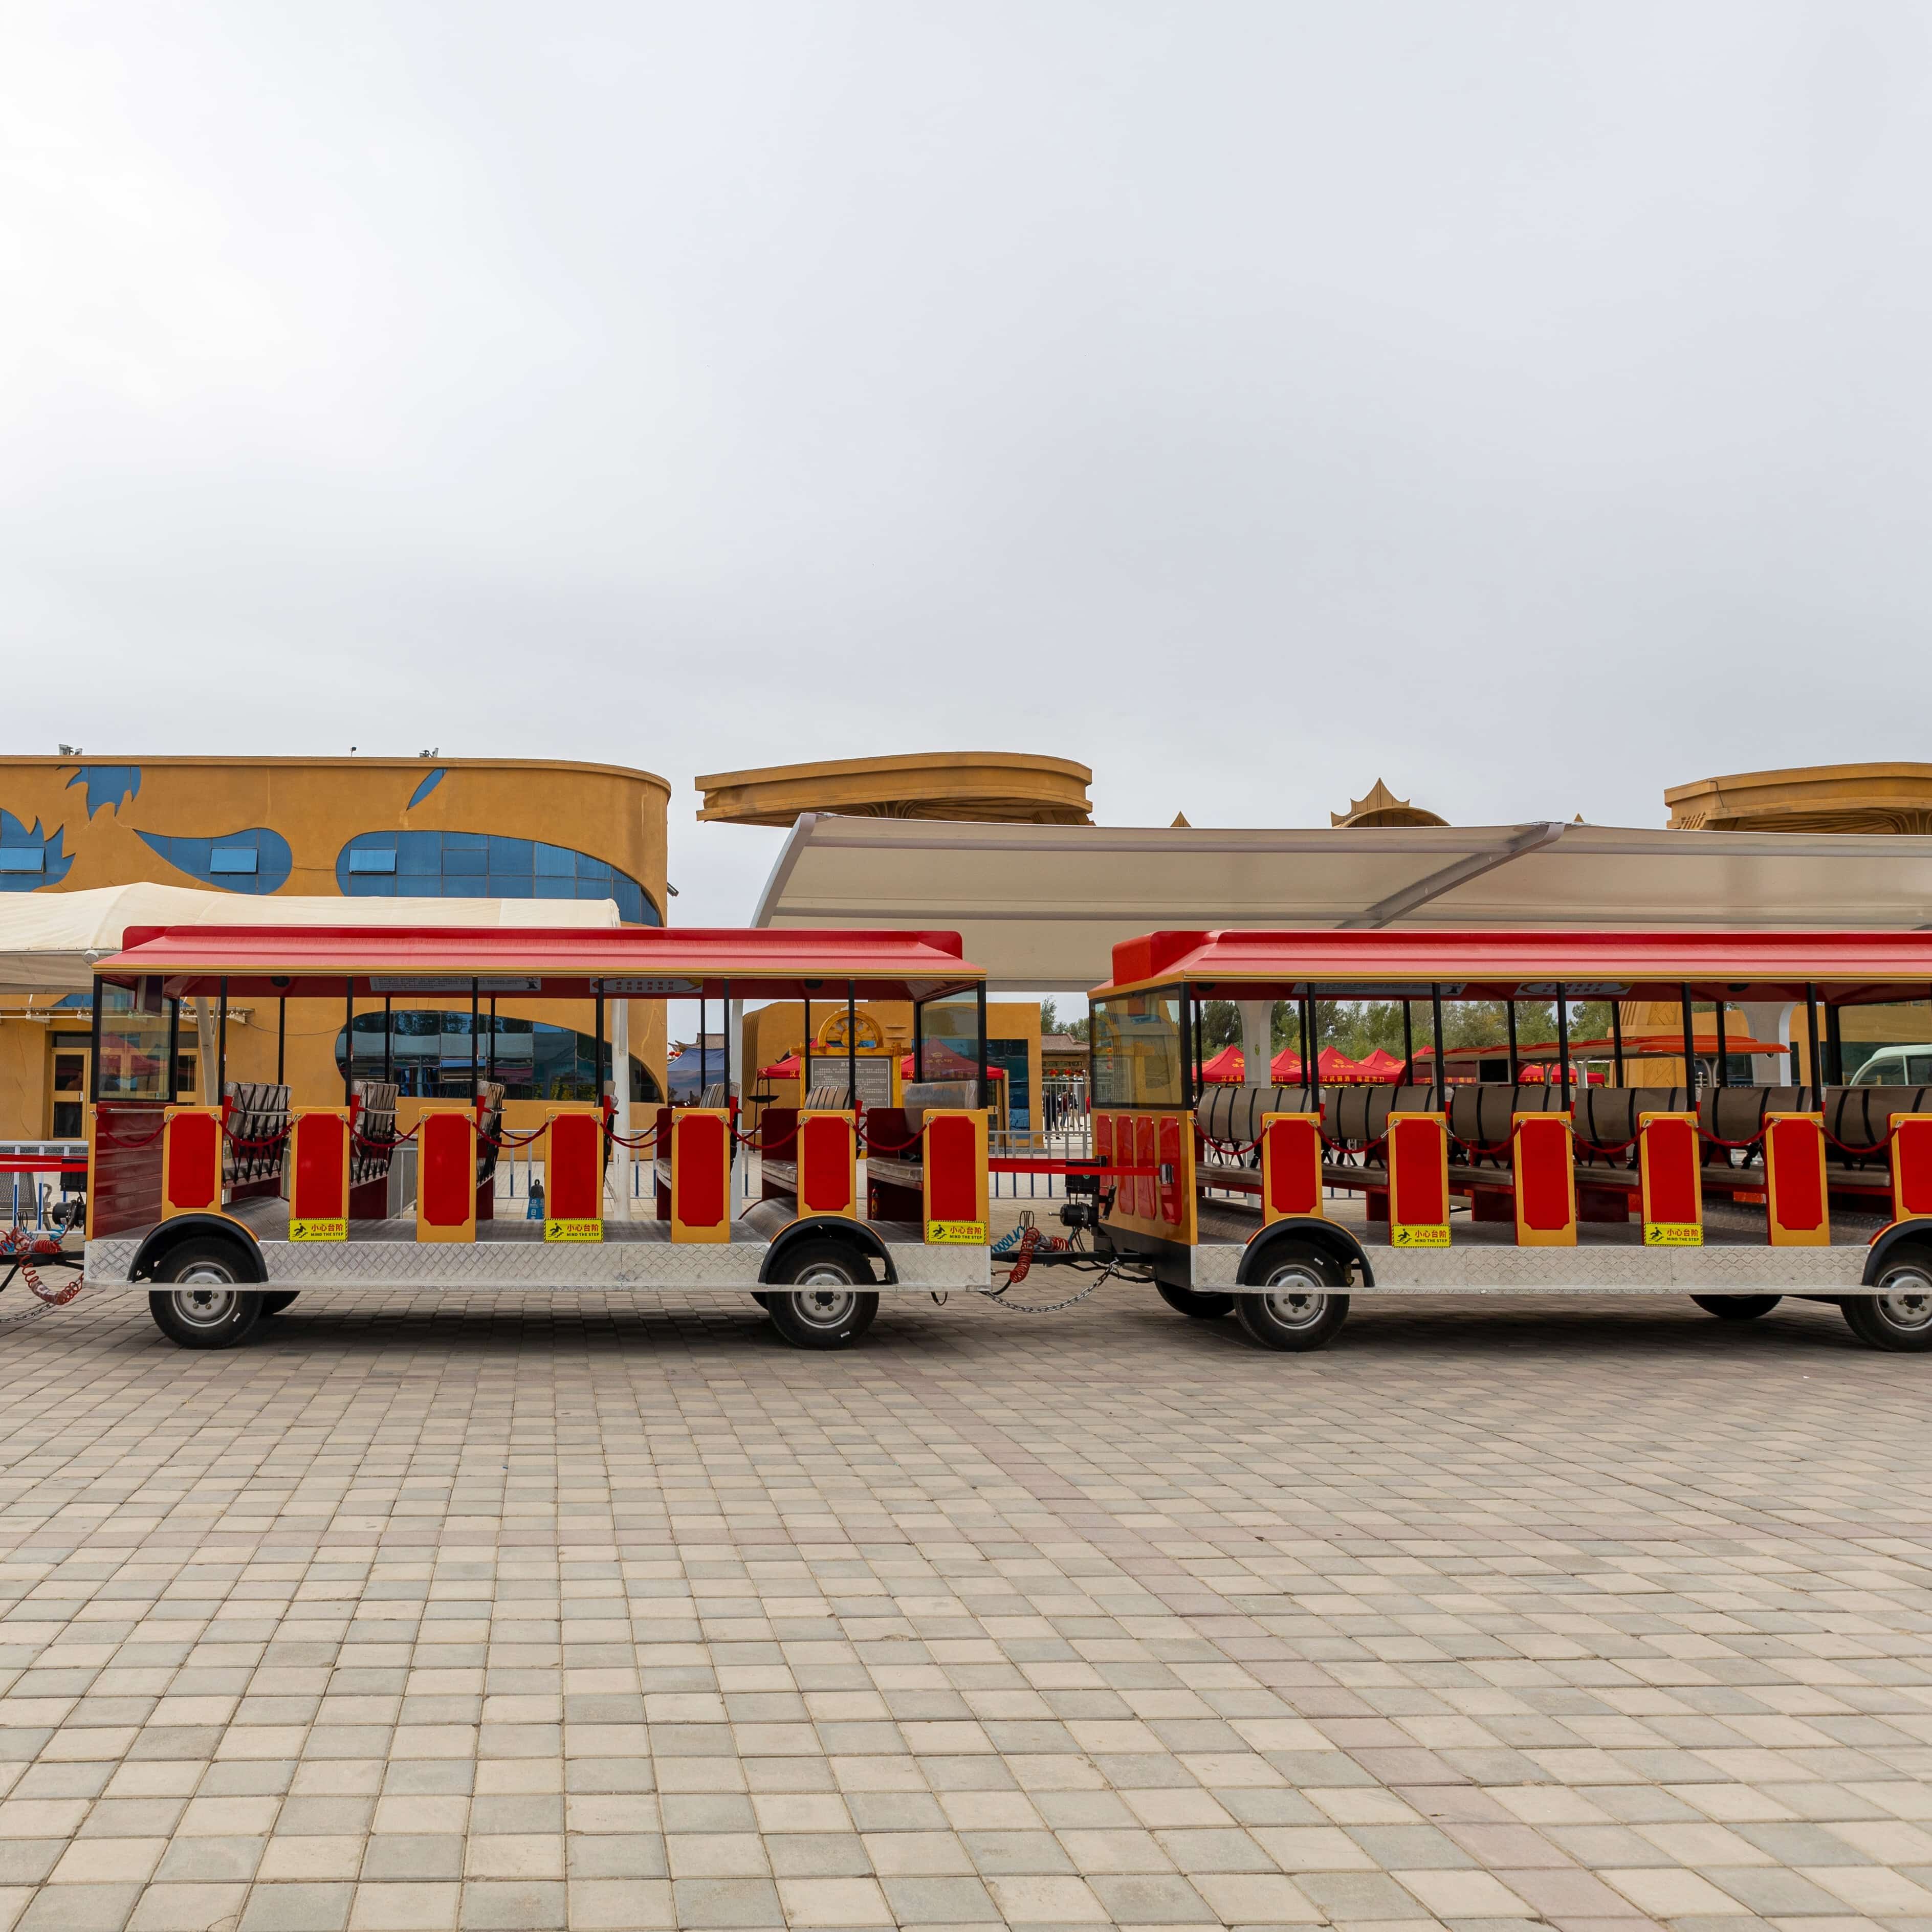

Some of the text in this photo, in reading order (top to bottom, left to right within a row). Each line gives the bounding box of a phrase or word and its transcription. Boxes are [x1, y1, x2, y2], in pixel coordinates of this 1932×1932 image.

[567, 1224, 599, 1232] 小心台阶
[950, 1226, 982, 1235] 小心台阶
